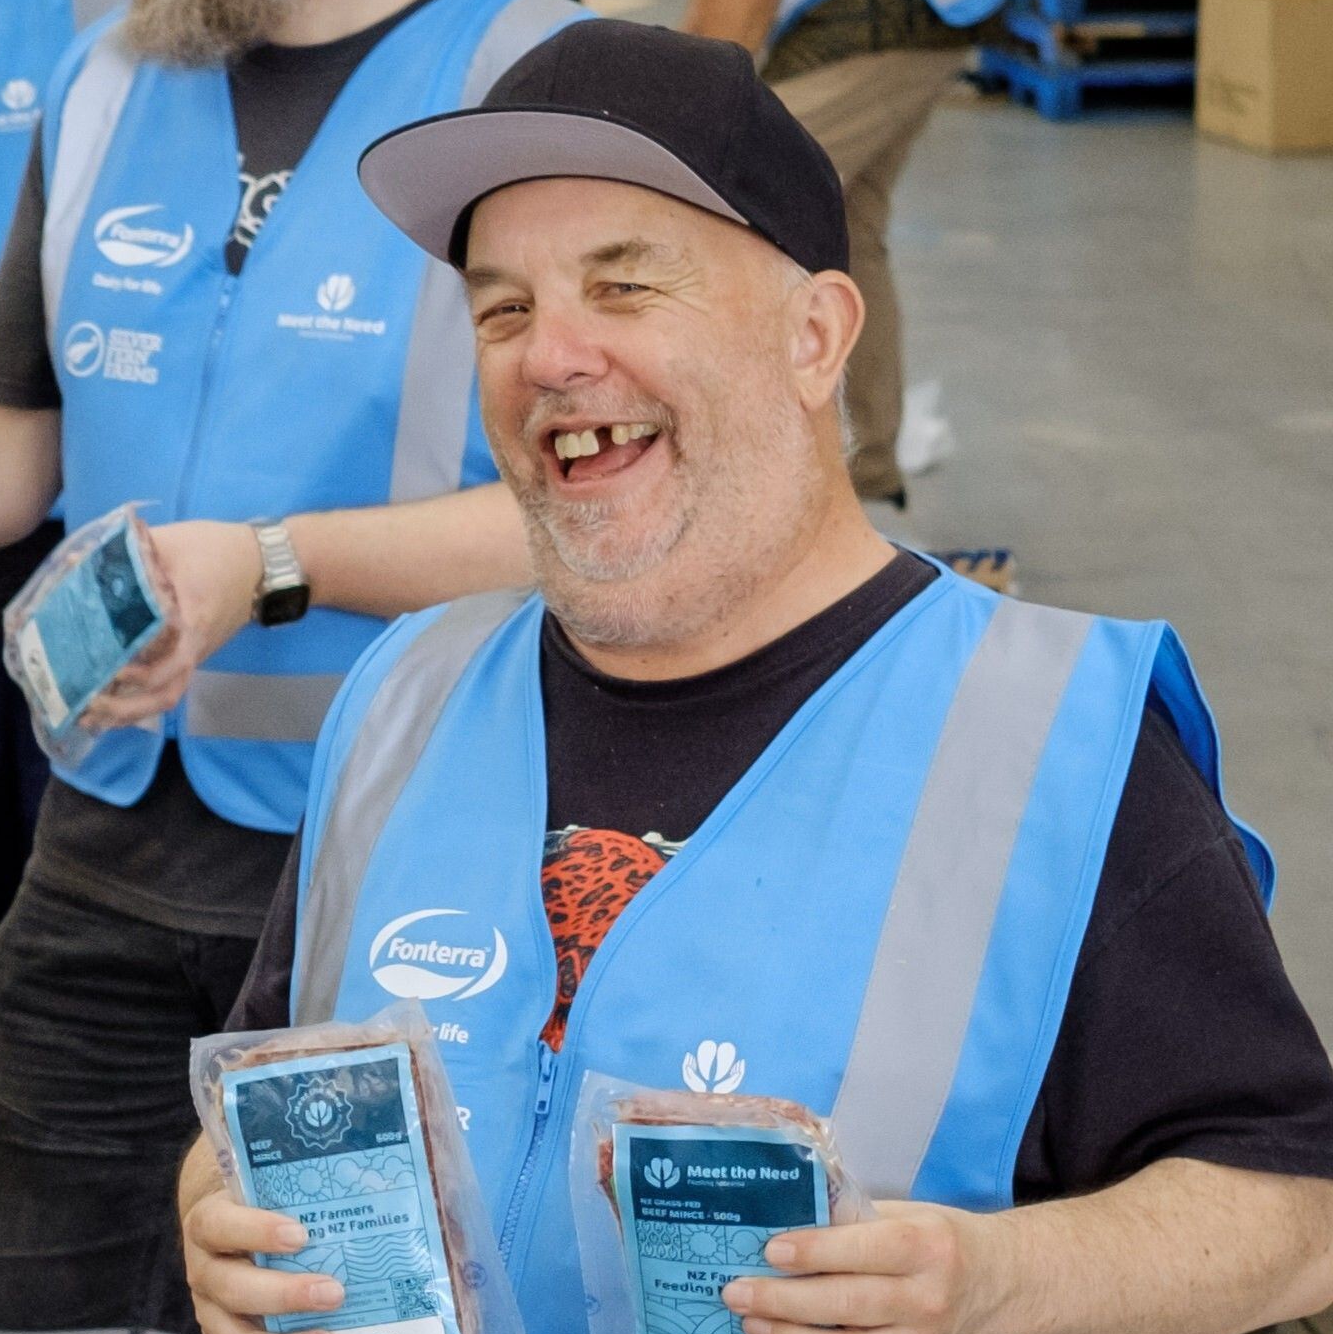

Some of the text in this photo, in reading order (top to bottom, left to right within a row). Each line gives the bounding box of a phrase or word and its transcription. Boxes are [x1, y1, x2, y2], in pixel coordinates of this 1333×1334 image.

[387, 937, 487, 969] Fonterra
[440, 1022, 469, 1044] life
[687, 1165, 800, 1180] Meet the Need
[300, 1204, 374, 1224] NZ Farmers
[642, 1208, 667, 1217] BEEF
[669, 1210, 705, 1220] MINCE
[328, 1223, 348, 1235] NZ
[349, 1213, 409, 1230] Families
[687, 1270, 706, 1281] NZ
[655, 1280, 714, 1296] Feeding
